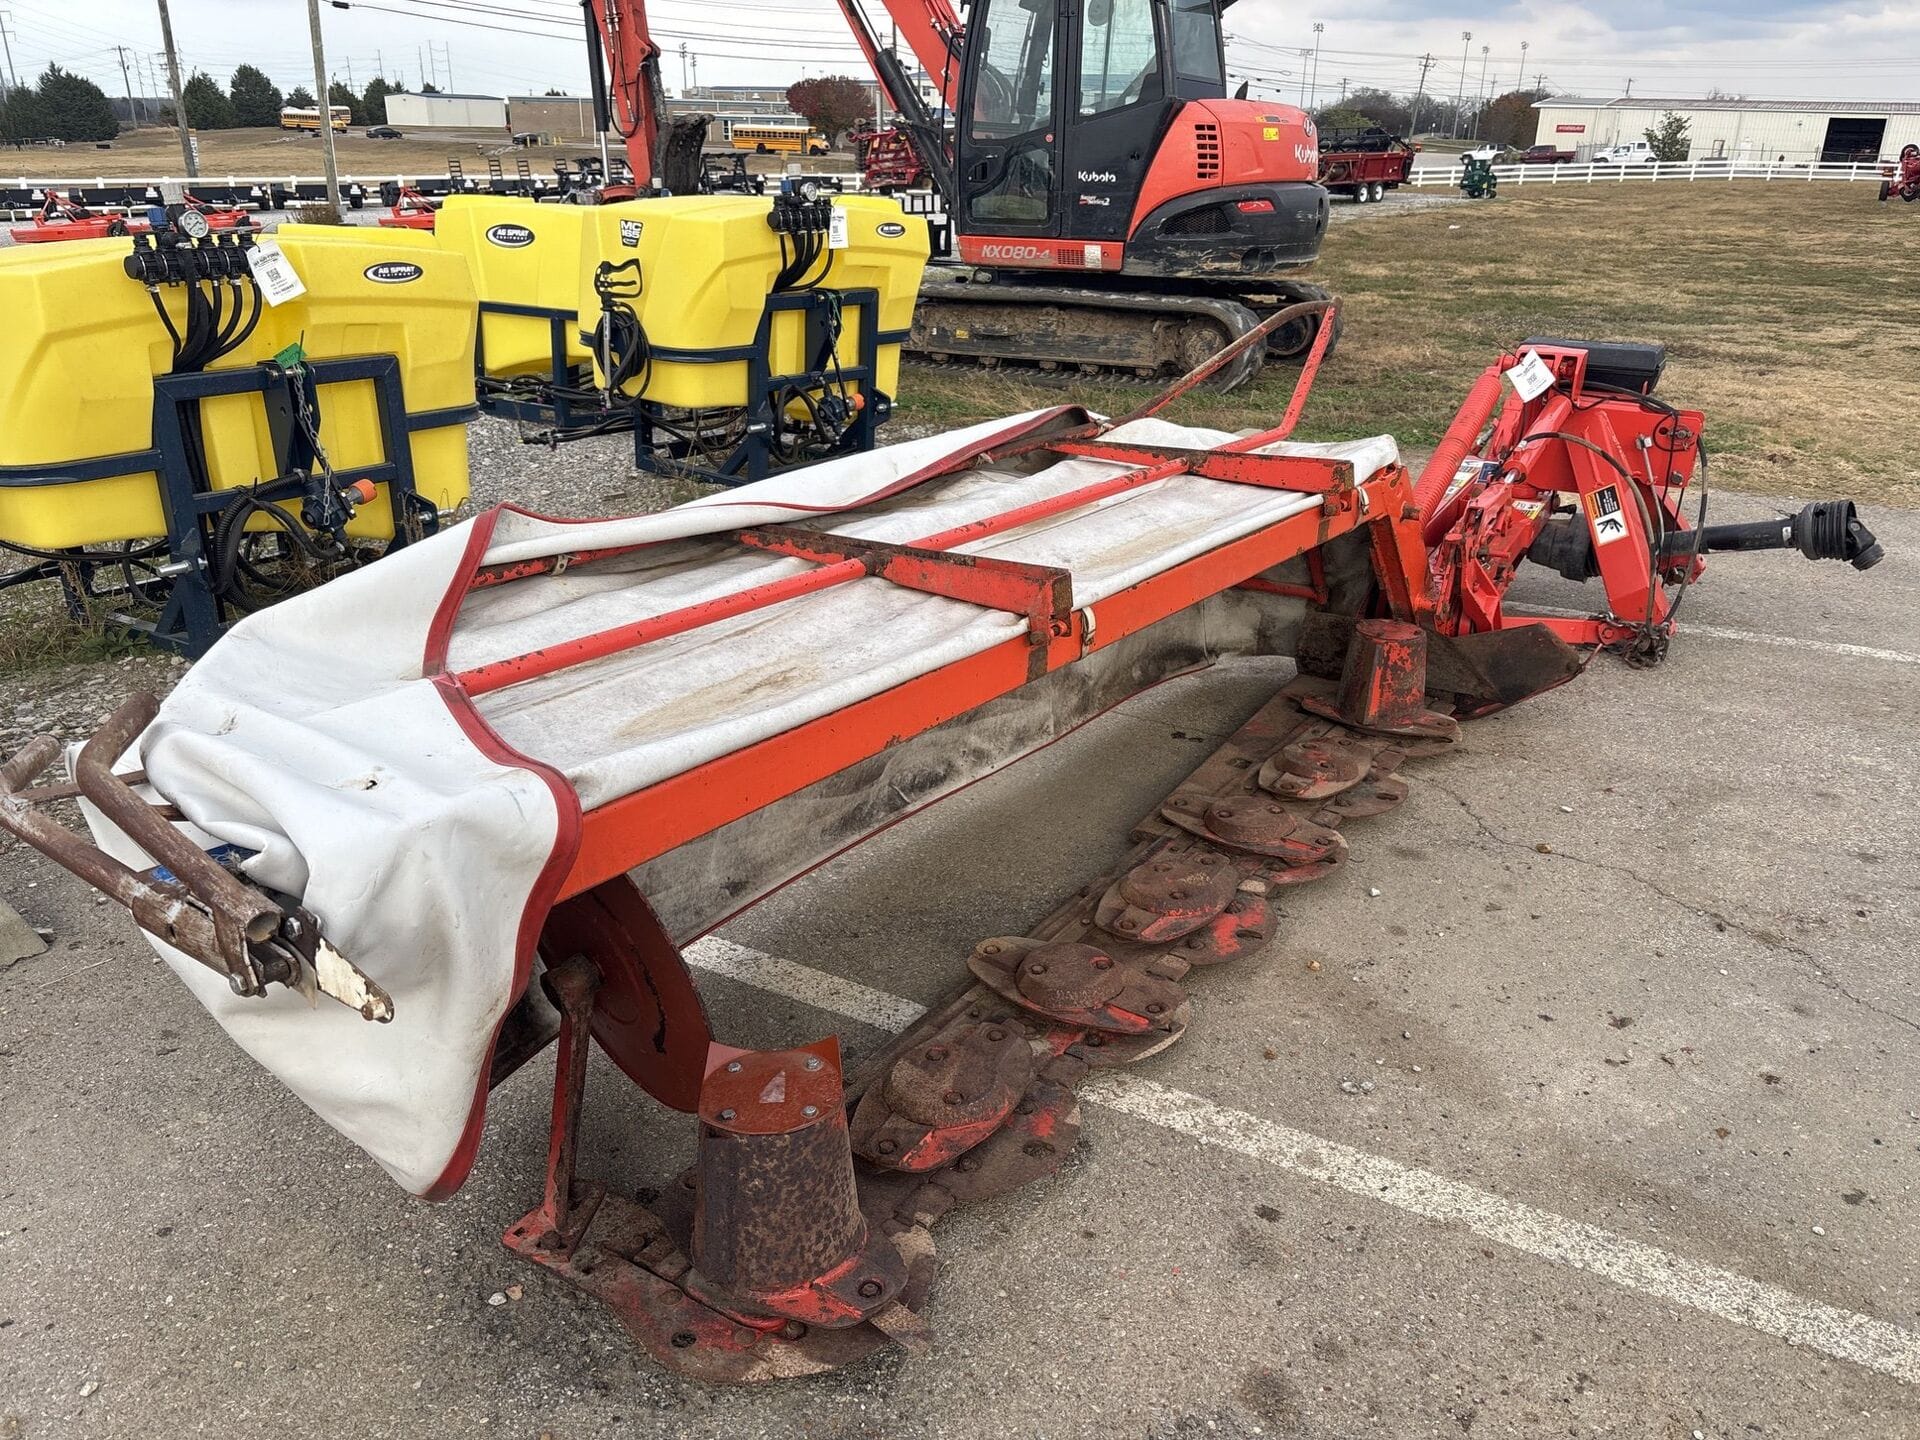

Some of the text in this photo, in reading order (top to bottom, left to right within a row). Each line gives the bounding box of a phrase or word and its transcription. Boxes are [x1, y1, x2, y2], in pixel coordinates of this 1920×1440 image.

[1078, 171, 1116, 182] Kubota
[621, 220, 642, 231] MC
[496, 228, 507, 236] AG
[621, 229, 640, 239] 165
[981, 244, 1050, 259] KX080-4
